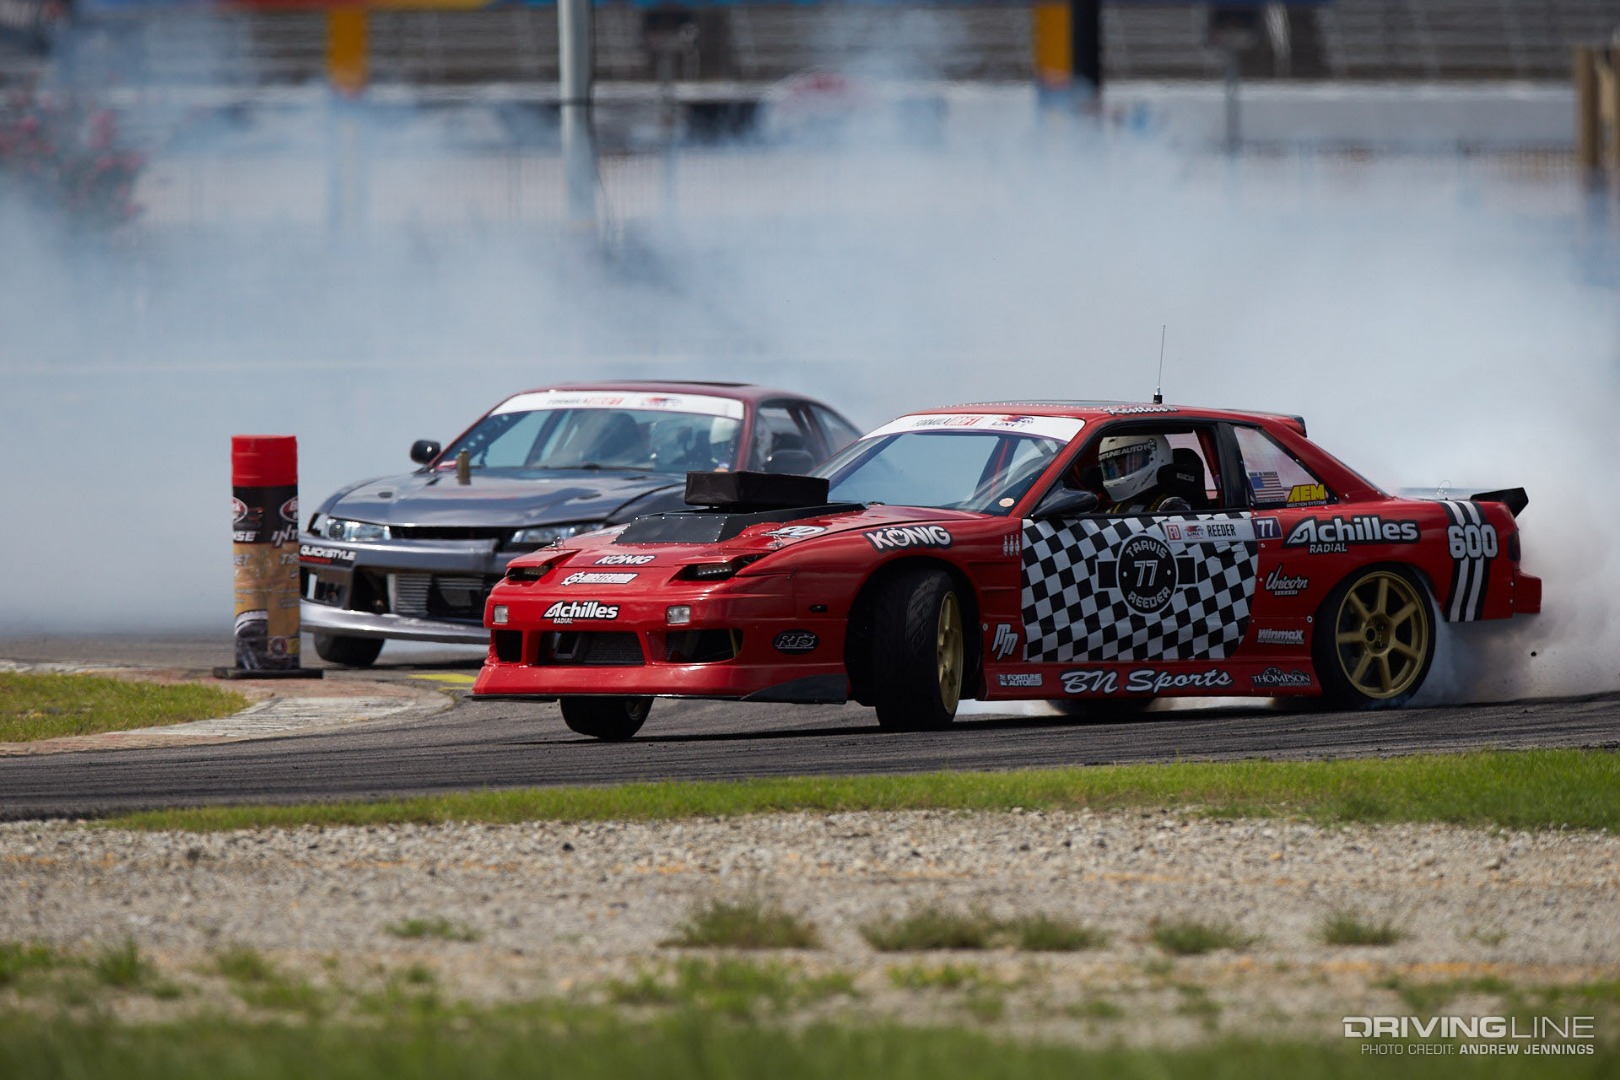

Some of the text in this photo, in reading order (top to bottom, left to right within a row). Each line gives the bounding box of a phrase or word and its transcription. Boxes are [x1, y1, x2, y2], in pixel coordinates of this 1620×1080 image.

[1287, 484, 1326, 502] AEM
[1207, 524, 1236, 537] REEDER
[1257, 520, 1274, 537] 77
[1287, 517, 1418, 544] Achilles
[1126, 540, 1167, 559] TRAVIS
[1310, 544, 1347, 553] RADIAL
[1448, 524, 1498, 559] 600
[1133, 560, 1159, 587] 77
[1265, 564, 1308, 590] Unicorn
[1127, 586, 1171, 609] REEDER
[543, 602, 619, 618] Achilles
[1061, 669, 1232, 693] BN Sports
[1251, 673, 1311, 684] THOMPSON
